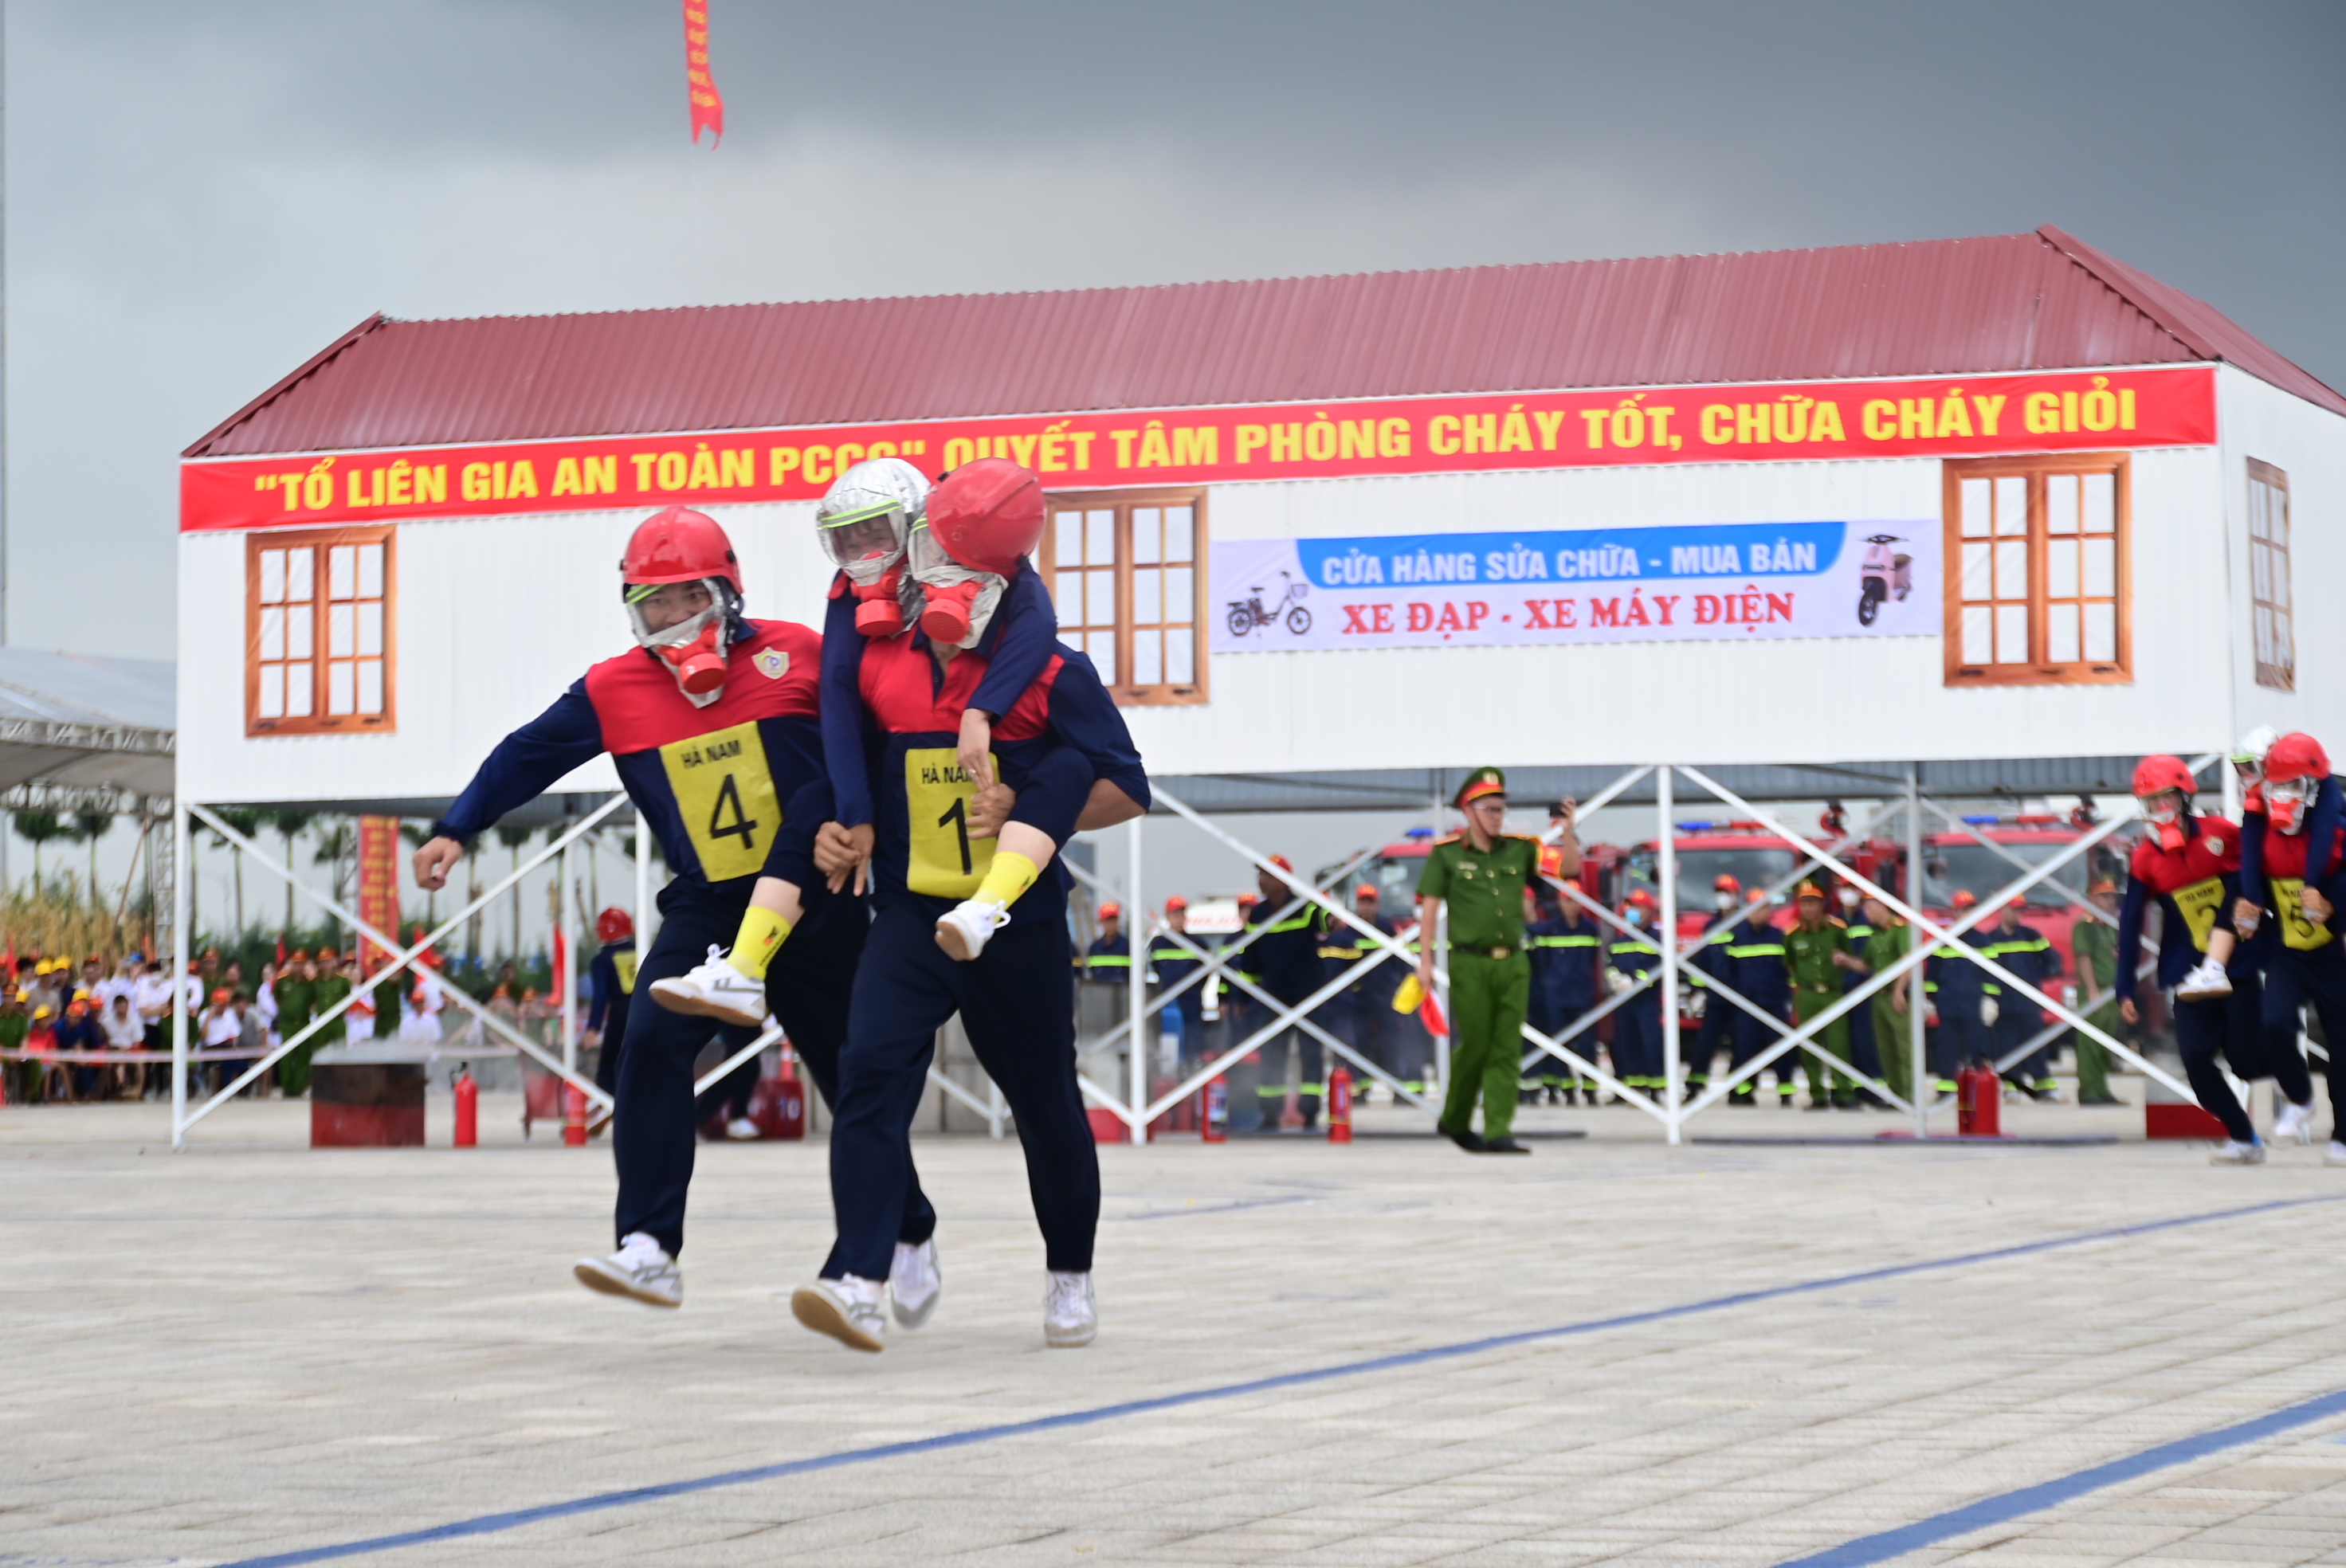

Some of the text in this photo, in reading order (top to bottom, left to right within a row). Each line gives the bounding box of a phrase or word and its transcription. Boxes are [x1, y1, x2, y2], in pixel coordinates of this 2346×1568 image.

[254, 457, 335, 511] "TỔ
[347, 459, 447, 508] LIÊN
[461, 460, 539, 501] GIA
[551, 455, 618, 496] AN
[630, 442, 755, 492] TOÀN
[1109, 420, 1218, 468] TÂM
[1234, 411, 1411, 464] PHÒNG
[1427, 404, 1566, 455] CHÁY
[1579, 394, 1683, 451] TỐT,
[1701, 394, 1847, 445] CHỮA
[1862, 388, 2007, 441] CHÁY
[2024, 375, 2136, 434] GIỎI
[1322, 547, 1384, 585] CỬA
[1392, 548, 1476, 582] HÀNG
[1485, 543, 1548, 580] SỬA
[1557, 543, 1641, 578] CHỮA
[1670, 543, 1741, 574] MUA
[1342, 604, 1395, 633] XE
[1406, 601, 1489, 641] ĐẠP
[1523, 598, 1577, 629] XE
[1590, 588, 1681, 628] MÁY
[1693, 584, 1795, 633] ĐIỆN
[681, 739, 743, 769] HÀ NAM
[922, 762, 972, 784] HÀ NA
[710, 774, 757, 849] 4
[939, 798, 971, 876] 1
